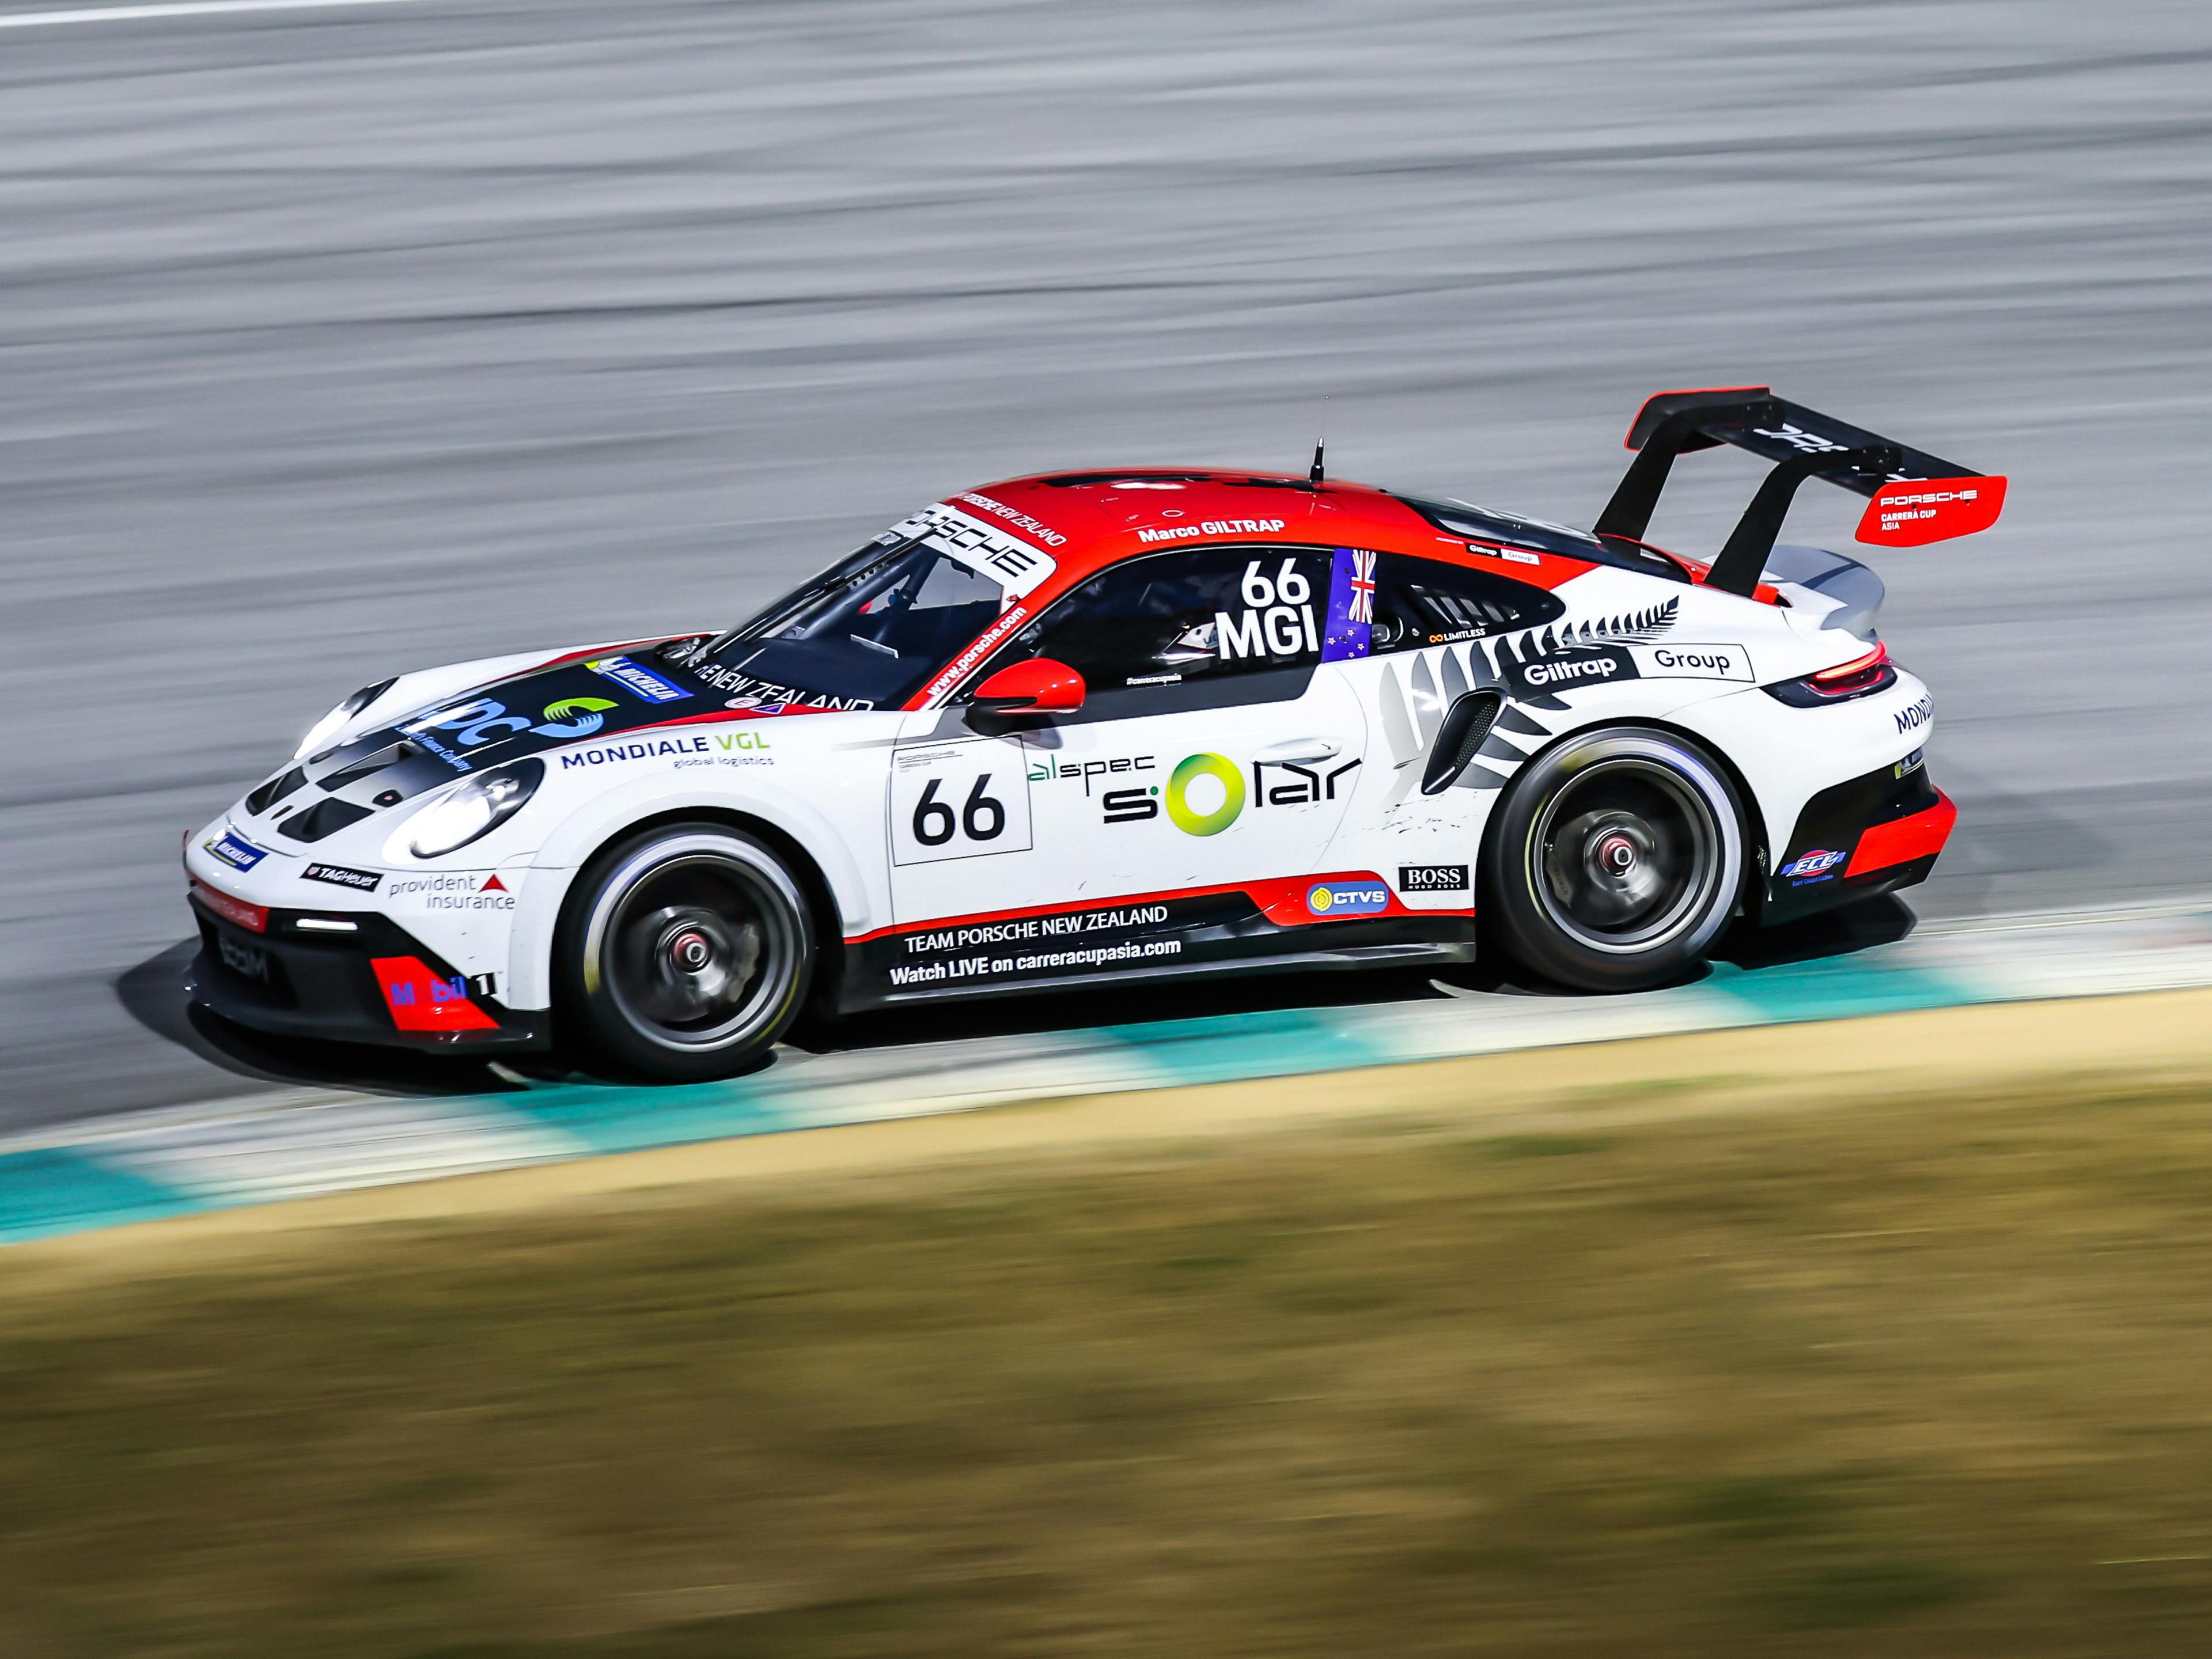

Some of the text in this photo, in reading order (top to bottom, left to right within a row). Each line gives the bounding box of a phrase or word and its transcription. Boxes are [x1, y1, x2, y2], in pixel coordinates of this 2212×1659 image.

[1880, 490, 1978, 507] PORSCHE
[993, 505, 1020, 520] NEW
[1010, 514, 1067, 547] ZEALAND
[1881, 509, 1937, 522] CARRERA CUP
[1881, 521, 1900, 531] ASIA
[905, 510, 1038, 578] ORSCHE
[1138, 520, 1285, 543] Marco GILTRAP
[1469, 544, 1533, 562] Giltrap Group
[1241, 557, 1310, 608] 66
[1215, 604, 1319, 660] MGI
[1444, 627, 1486, 642] LIMITLESS
[927, 607, 1028, 696] www.porsche.com
[1524, 649, 1730, 685] Giltrap Group
[613, 668, 680, 700] MICHELIN
[707, 668, 756, 693] NEW
[560, 732, 771, 770] MONDIALE VGL
[673, 756, 774, 769] global logistics
[1027, 753, 1156, 797] alspec
[912, 773, 1005, 846] 66
[389, 874, 477, 899] provident
[1407, 868, 1461, 884] BOSS
[426, 893, 516, 910] insurance
[1333, 890, 1386, 905] CTVS
[905, 906, 1168, 953] TEAM PORSCHE NEW ZEALAND
[890, 940, 1181, 986] Watch LIVE on carreracupasia.com
[391, 975, 490, 1006] Mbil 1
